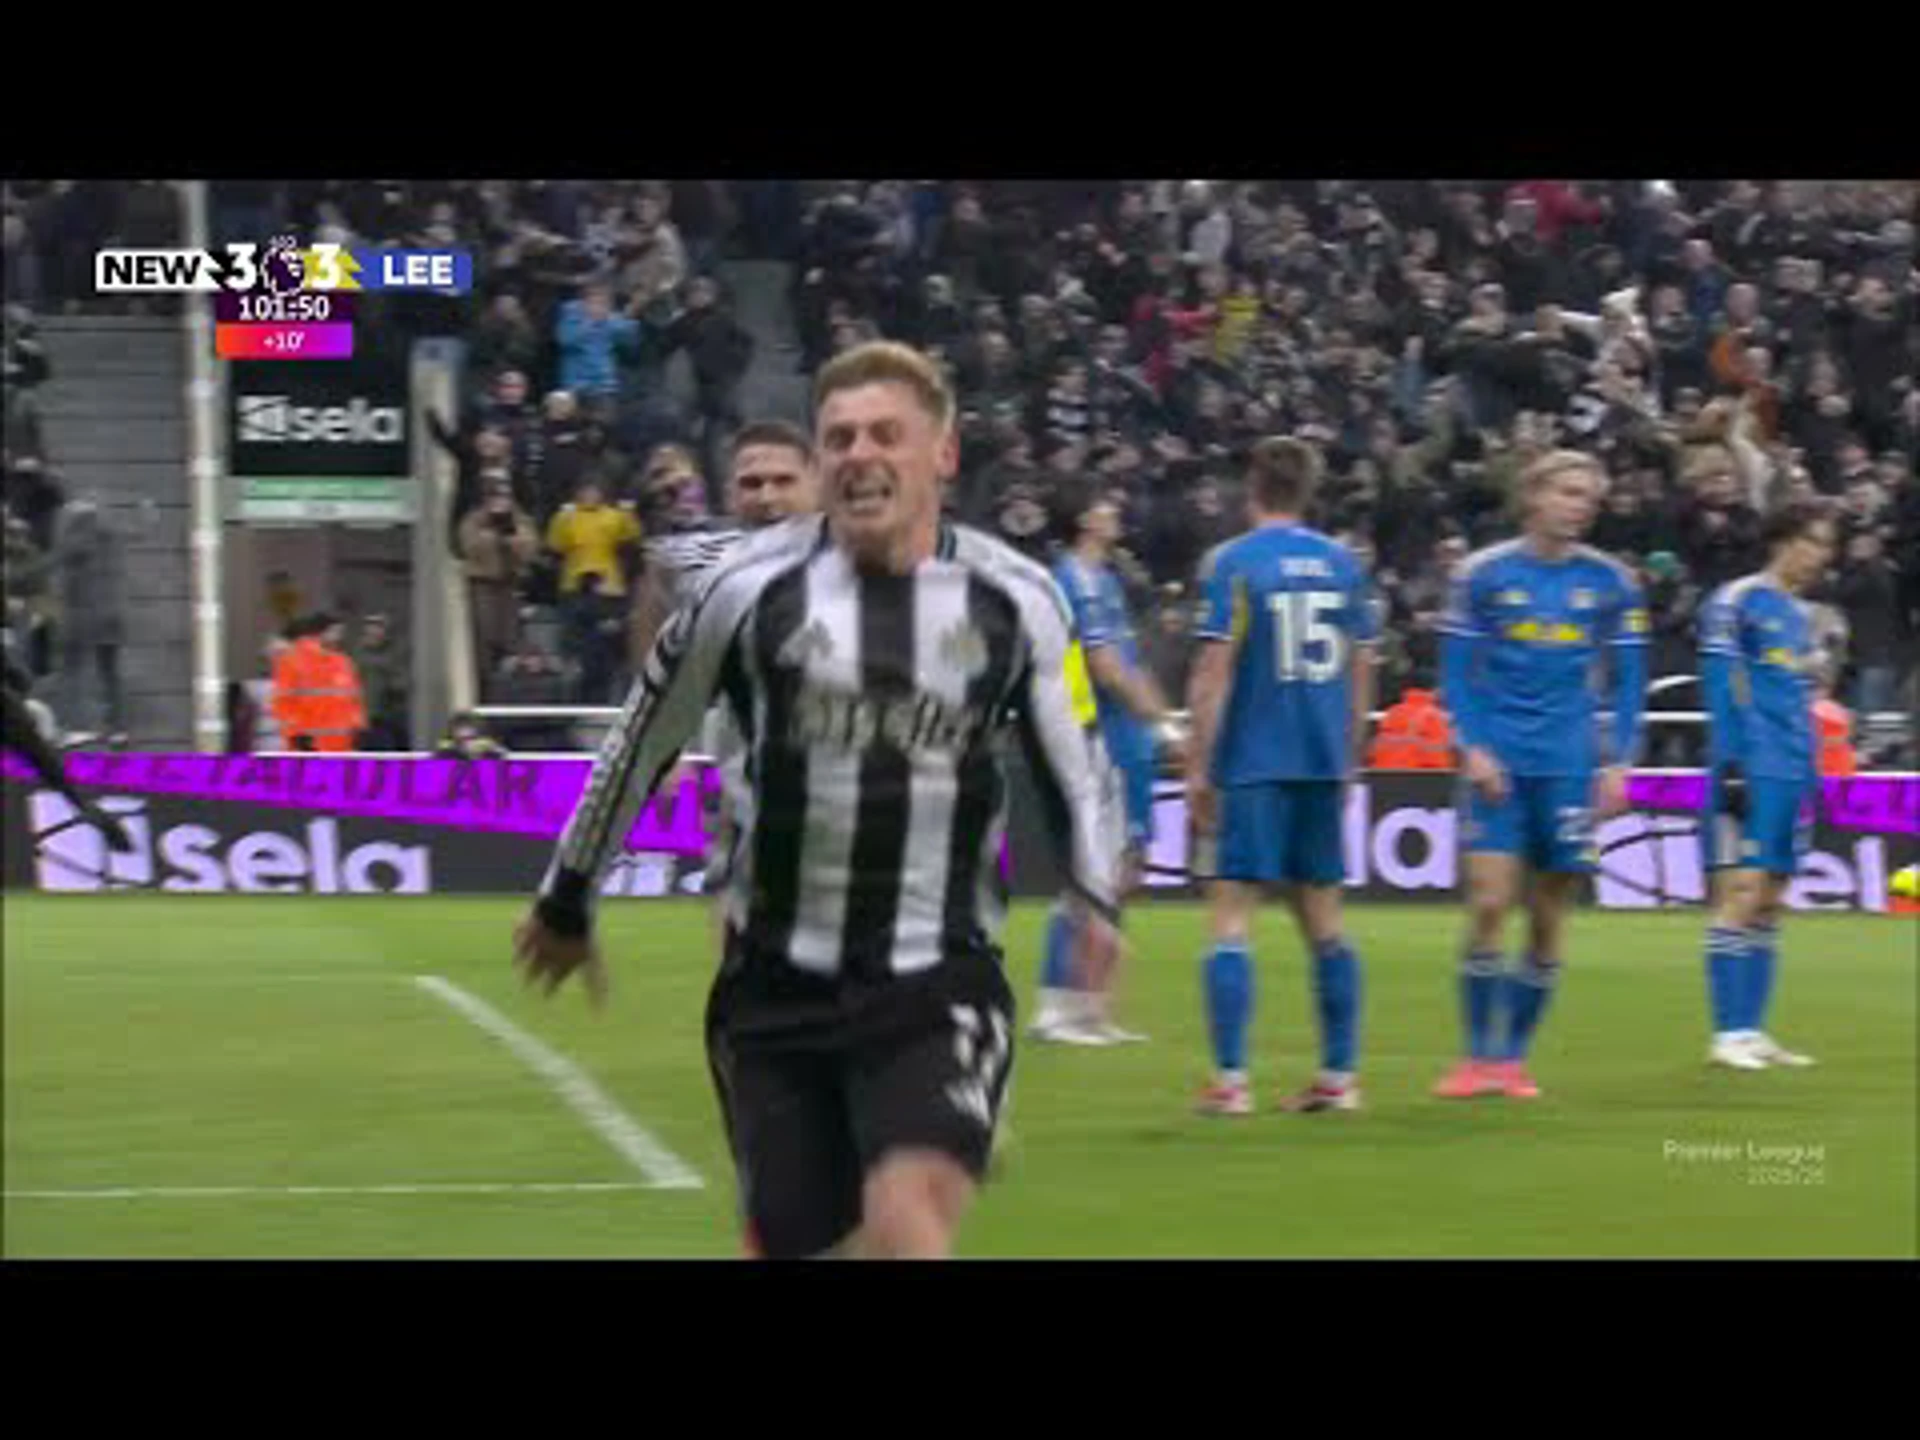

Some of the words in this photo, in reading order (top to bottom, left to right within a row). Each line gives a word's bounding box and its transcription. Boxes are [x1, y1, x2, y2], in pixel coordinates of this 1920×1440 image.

[288, 397, 404, 443] sela
[1268, 590, 1346, 683] 15
[156, 816, 430, 894] sela
